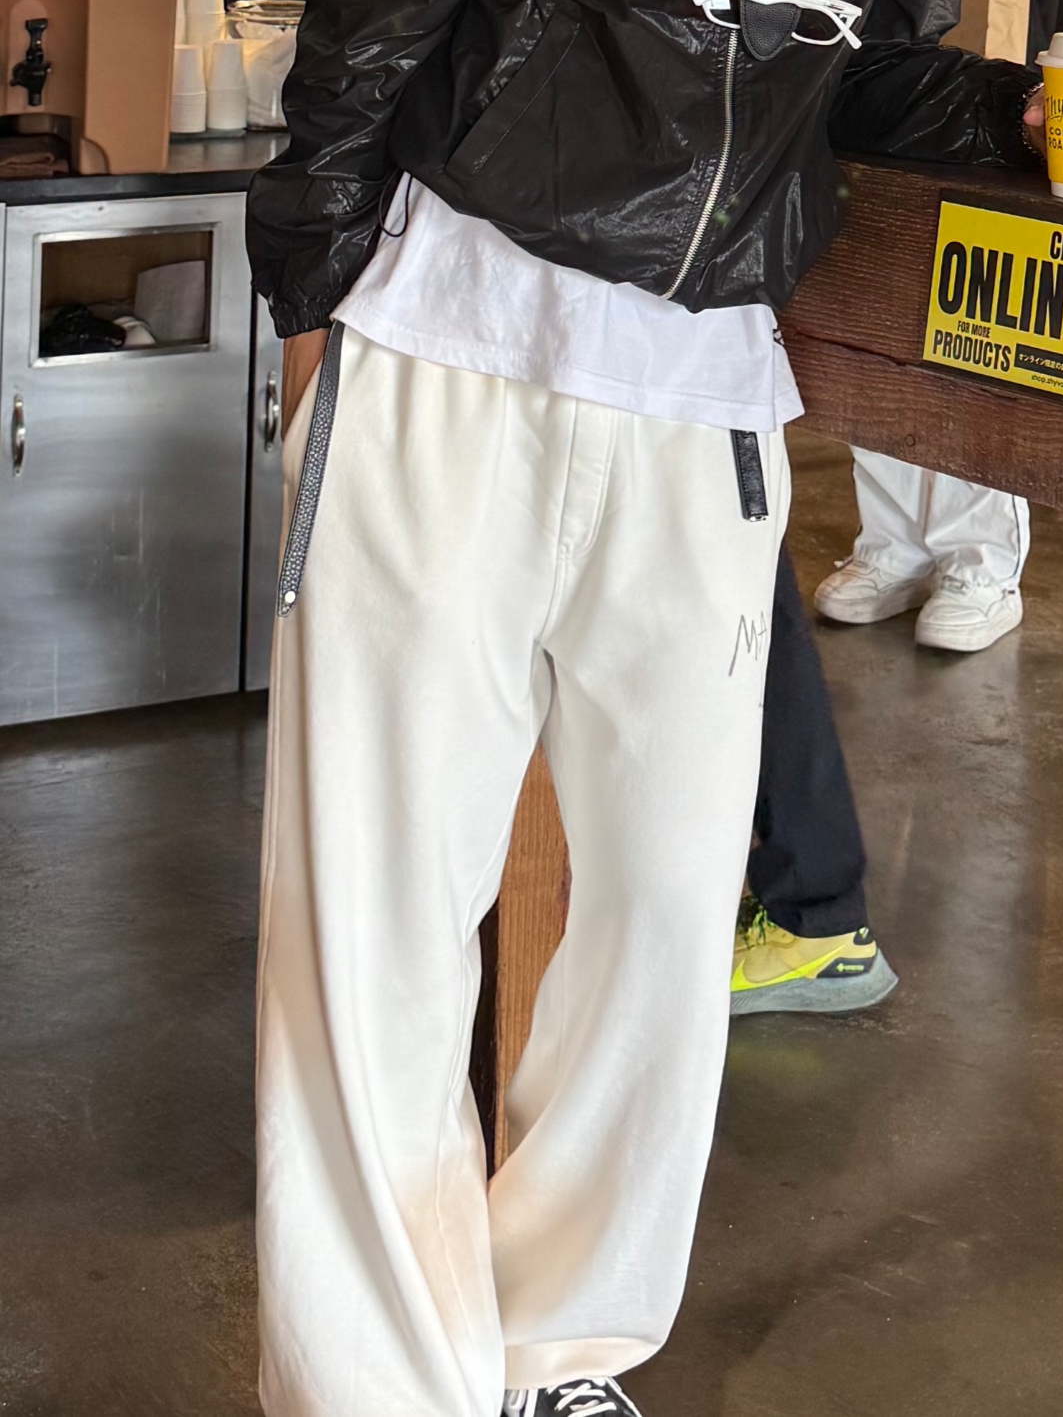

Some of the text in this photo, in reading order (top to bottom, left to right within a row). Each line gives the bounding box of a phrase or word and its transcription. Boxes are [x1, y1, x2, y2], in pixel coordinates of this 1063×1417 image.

[957, 320, 991, 338] FOR MORE
[932, 329, 1011, 372] PRODUCTS
